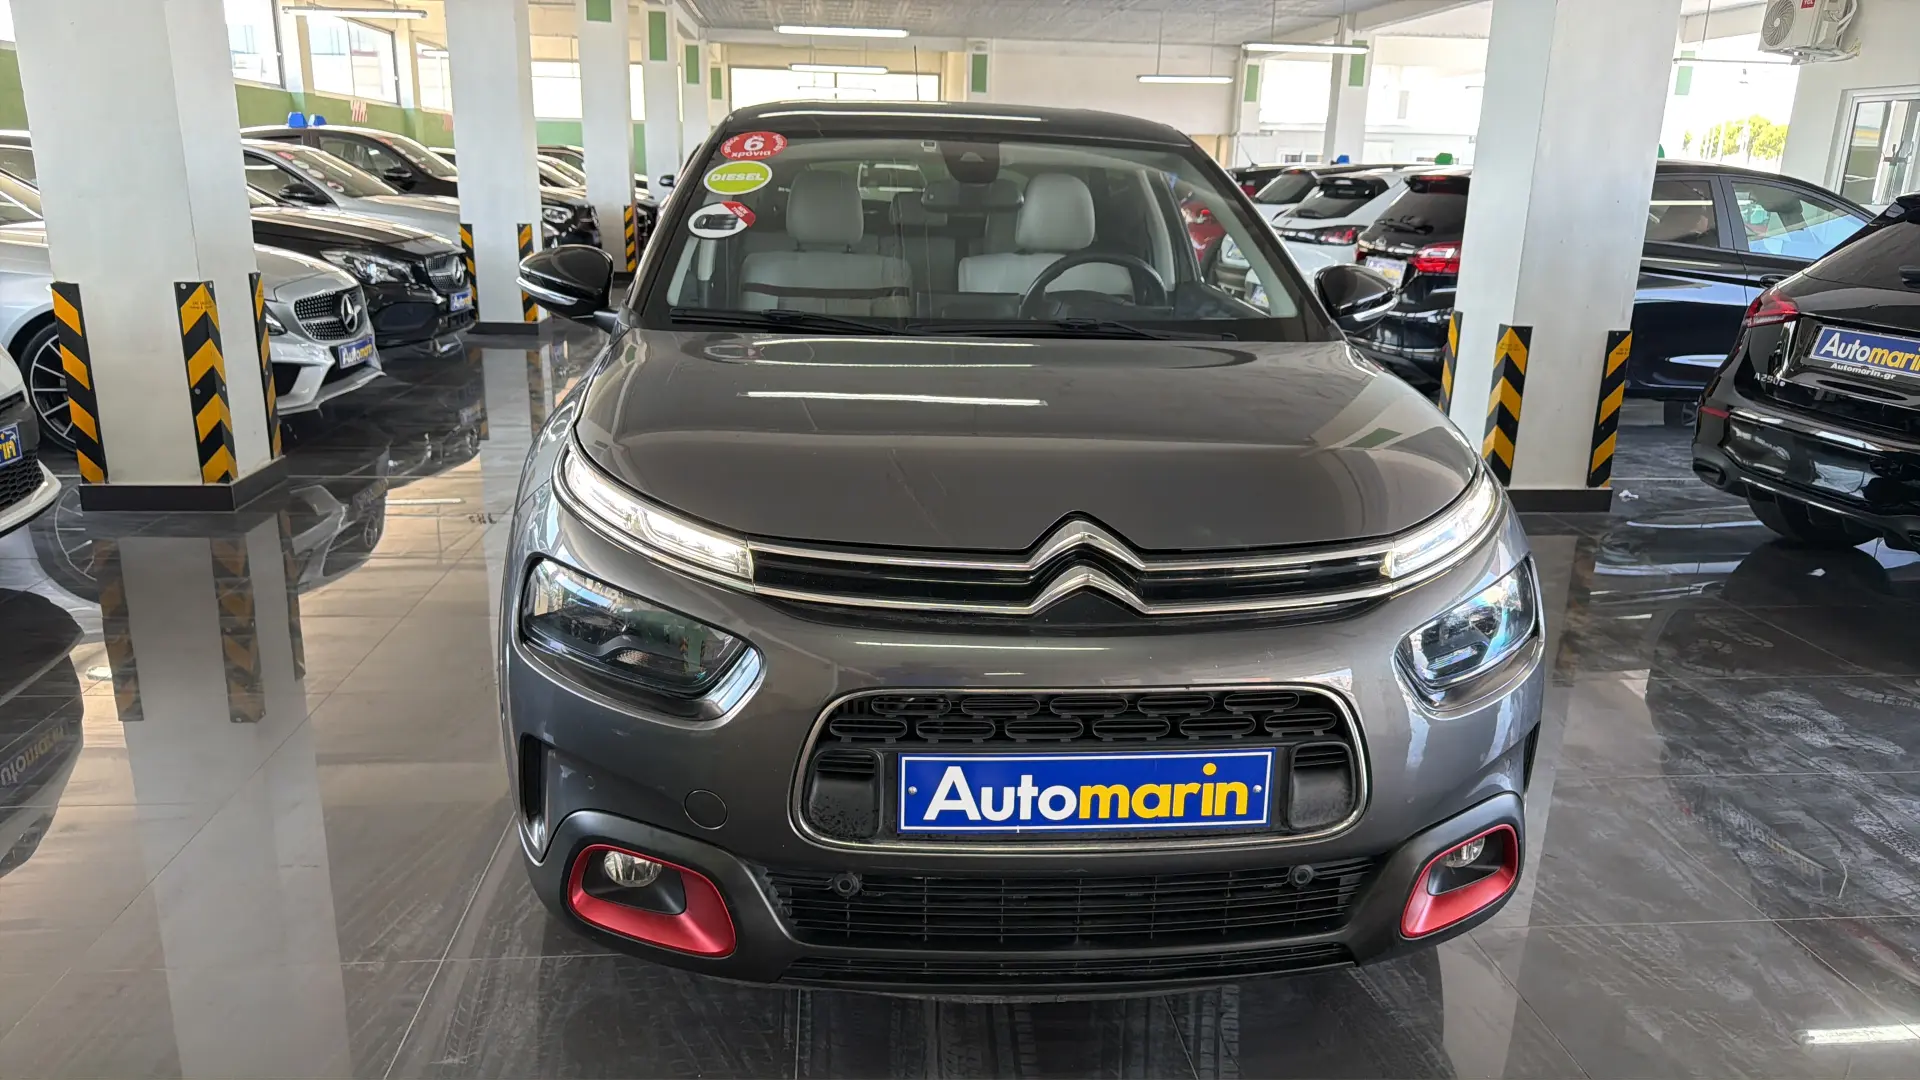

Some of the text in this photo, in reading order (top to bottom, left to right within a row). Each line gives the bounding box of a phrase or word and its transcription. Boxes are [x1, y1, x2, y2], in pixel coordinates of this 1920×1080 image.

[743, 136, 765, 151] 6
[731, 150, 771, 158] χρόνια
[711, 173, 765, 182] DIESEL
[1830, 363, 1896, 380] Automarin.gr
[923, 762, 1248, 821] Automarin
